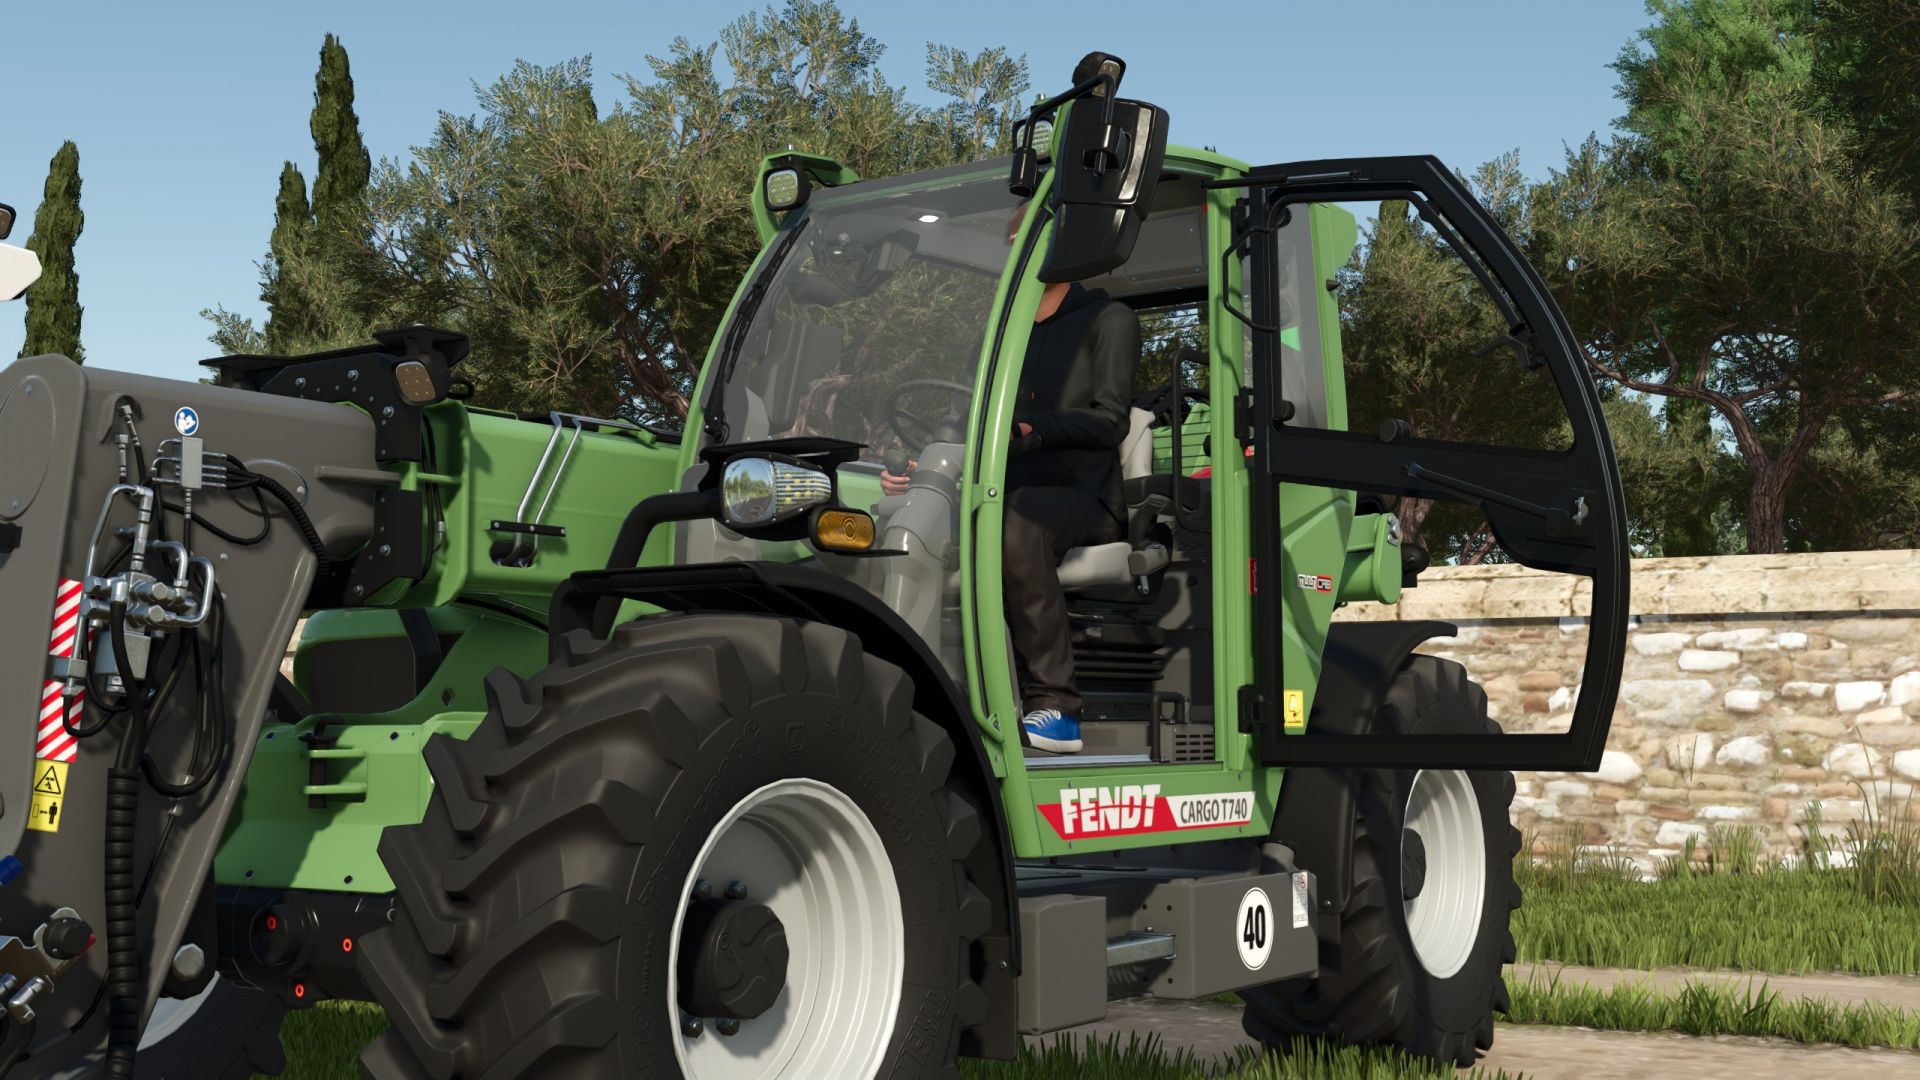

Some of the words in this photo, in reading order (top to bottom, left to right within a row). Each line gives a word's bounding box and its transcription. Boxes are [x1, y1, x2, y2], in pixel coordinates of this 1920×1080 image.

[1060, 784, 1161, 834] FENDT
[1180, 799, 1219, 824] CARGO
[1221, 798, 1248, 822] T740
[1243, 904, 1266, 950] 40
